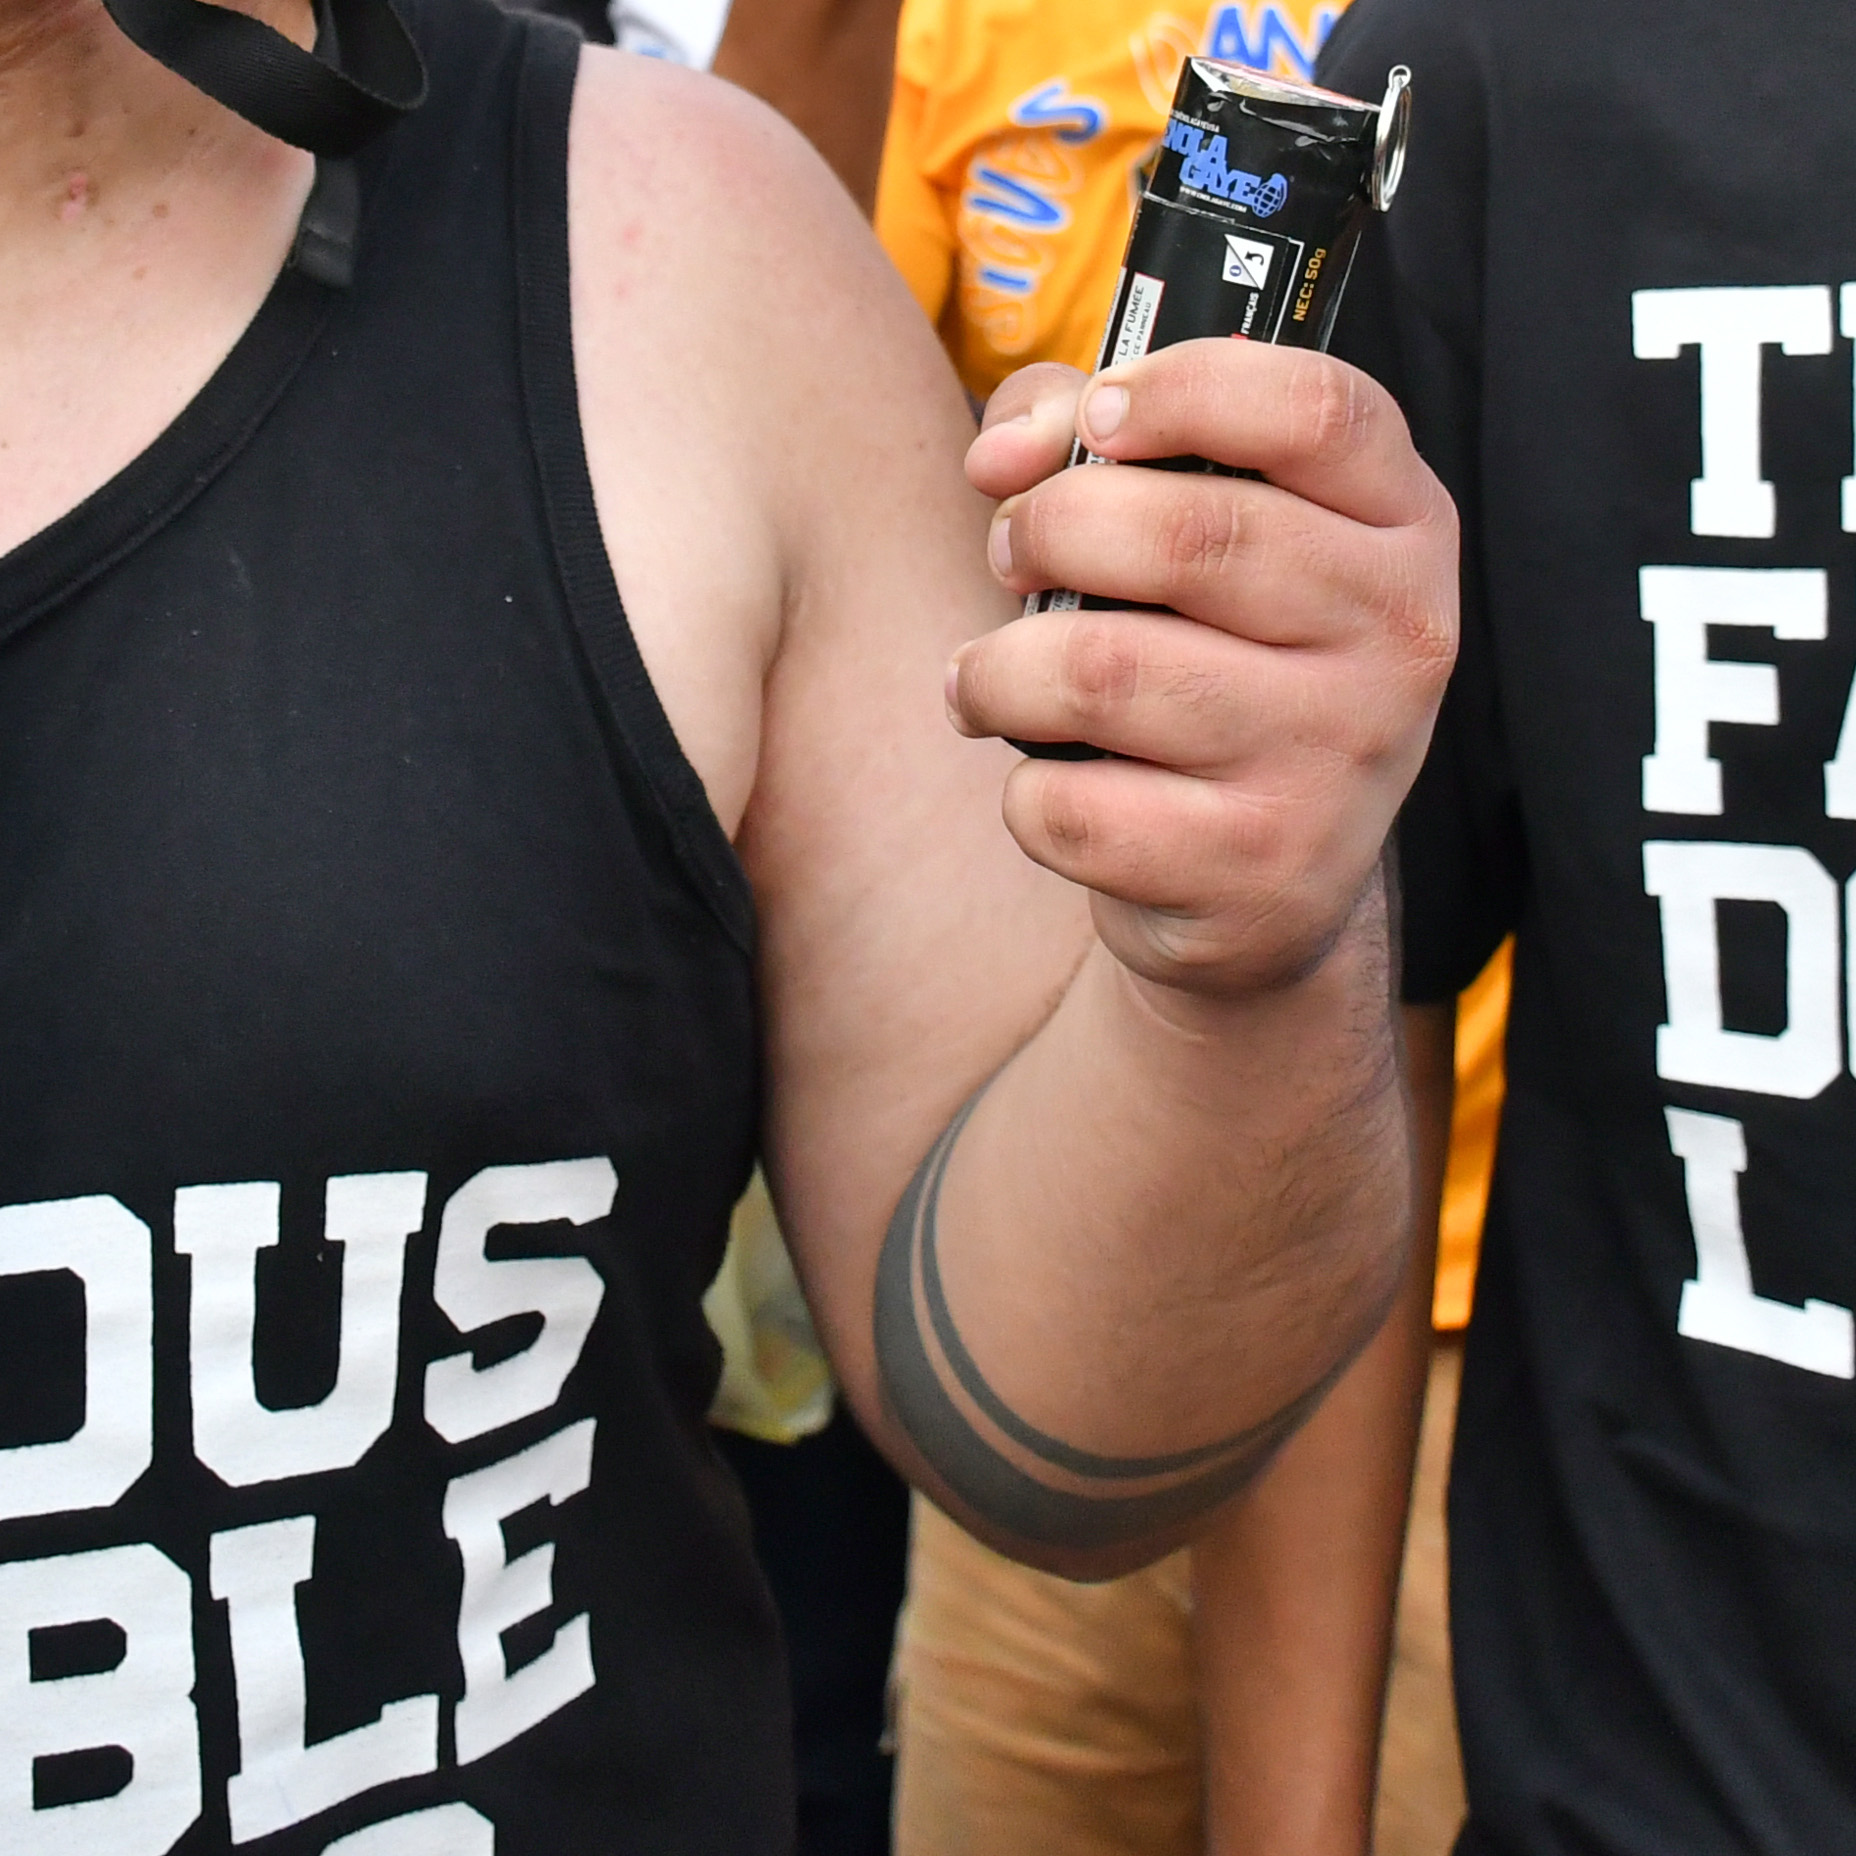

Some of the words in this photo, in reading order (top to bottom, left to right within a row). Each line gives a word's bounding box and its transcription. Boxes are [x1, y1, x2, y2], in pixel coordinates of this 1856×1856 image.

[1163, 118, 1229, 165] NOLA
[1179, 154, 1262, 207] GAYE
[1292, 283, 1313, 322] NEC:
[1304, 247, 1327, 281] 50g
[1663, 1106, 1856, 1379] L
